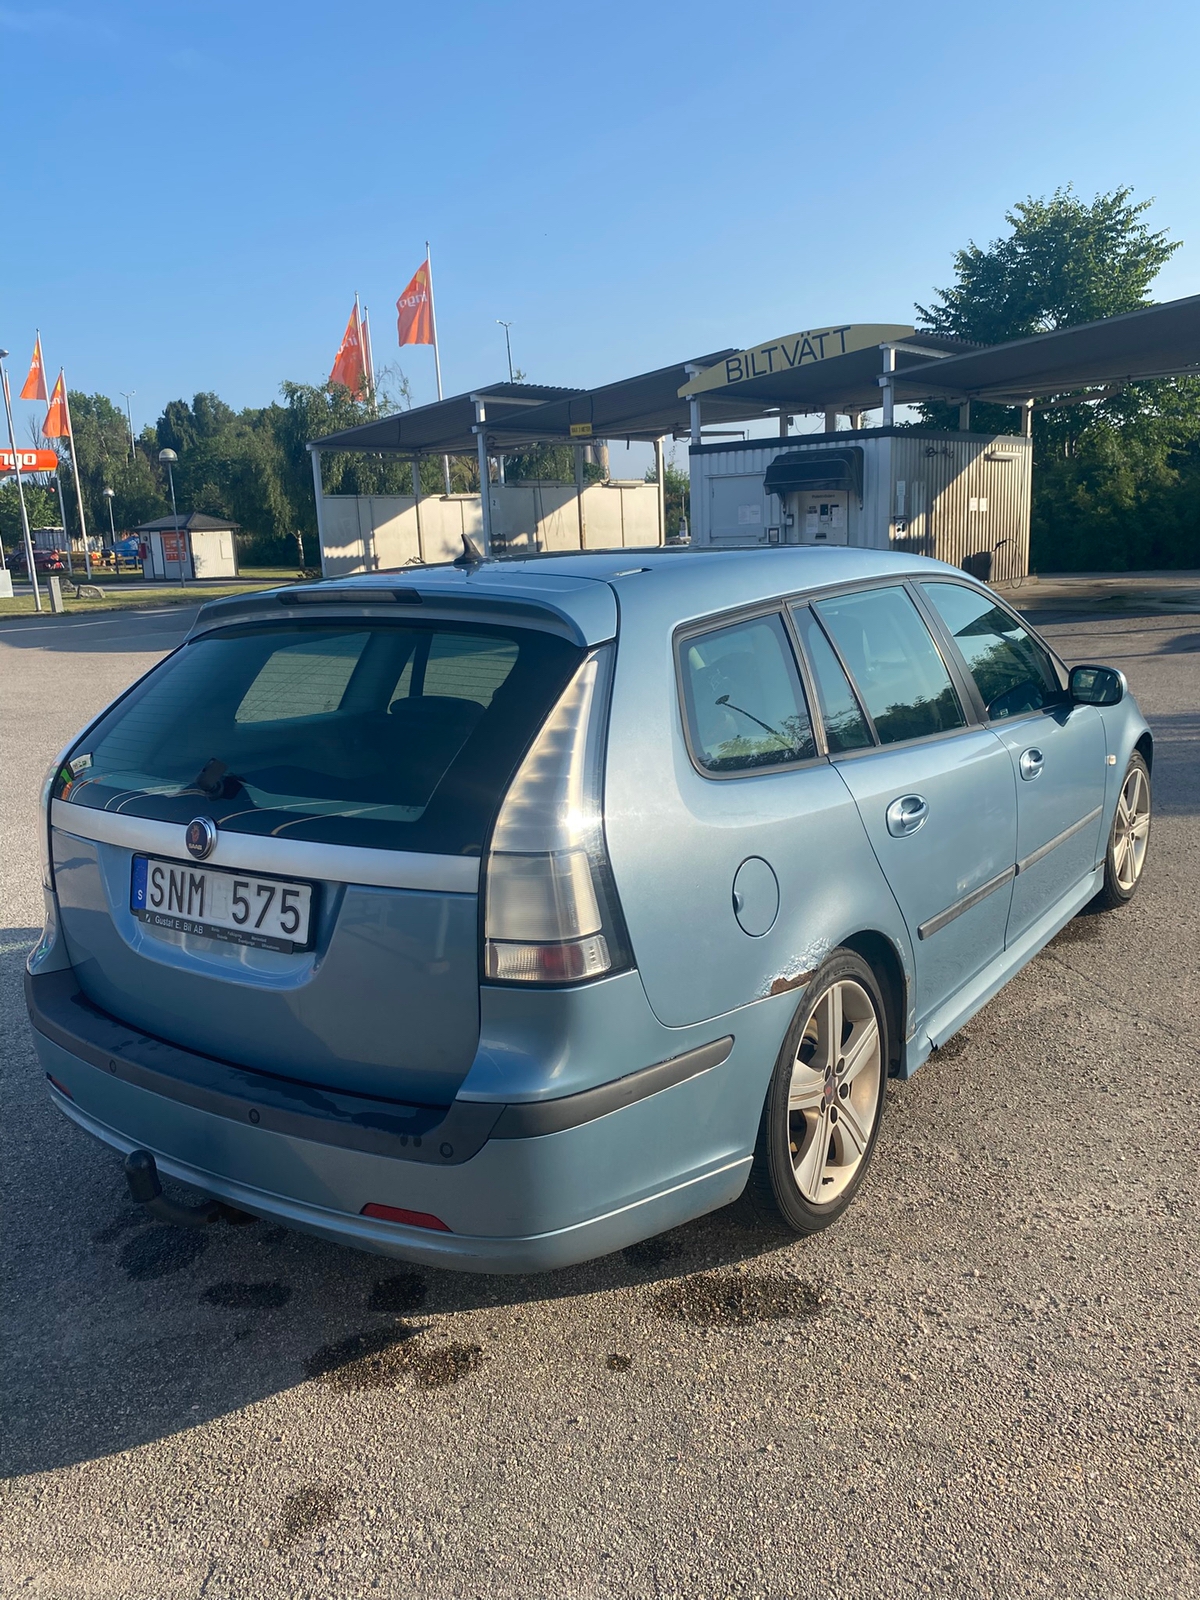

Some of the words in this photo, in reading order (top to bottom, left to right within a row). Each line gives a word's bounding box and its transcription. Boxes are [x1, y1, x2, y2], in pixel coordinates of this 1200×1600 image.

[725, 326, 851, 384] BILTVÄTT
[137, 890, 143, 901] S
[150, 867, 205, 917] SNM
[232, 880, 300, 934] 575
[193, 924, 204, 935] AB
